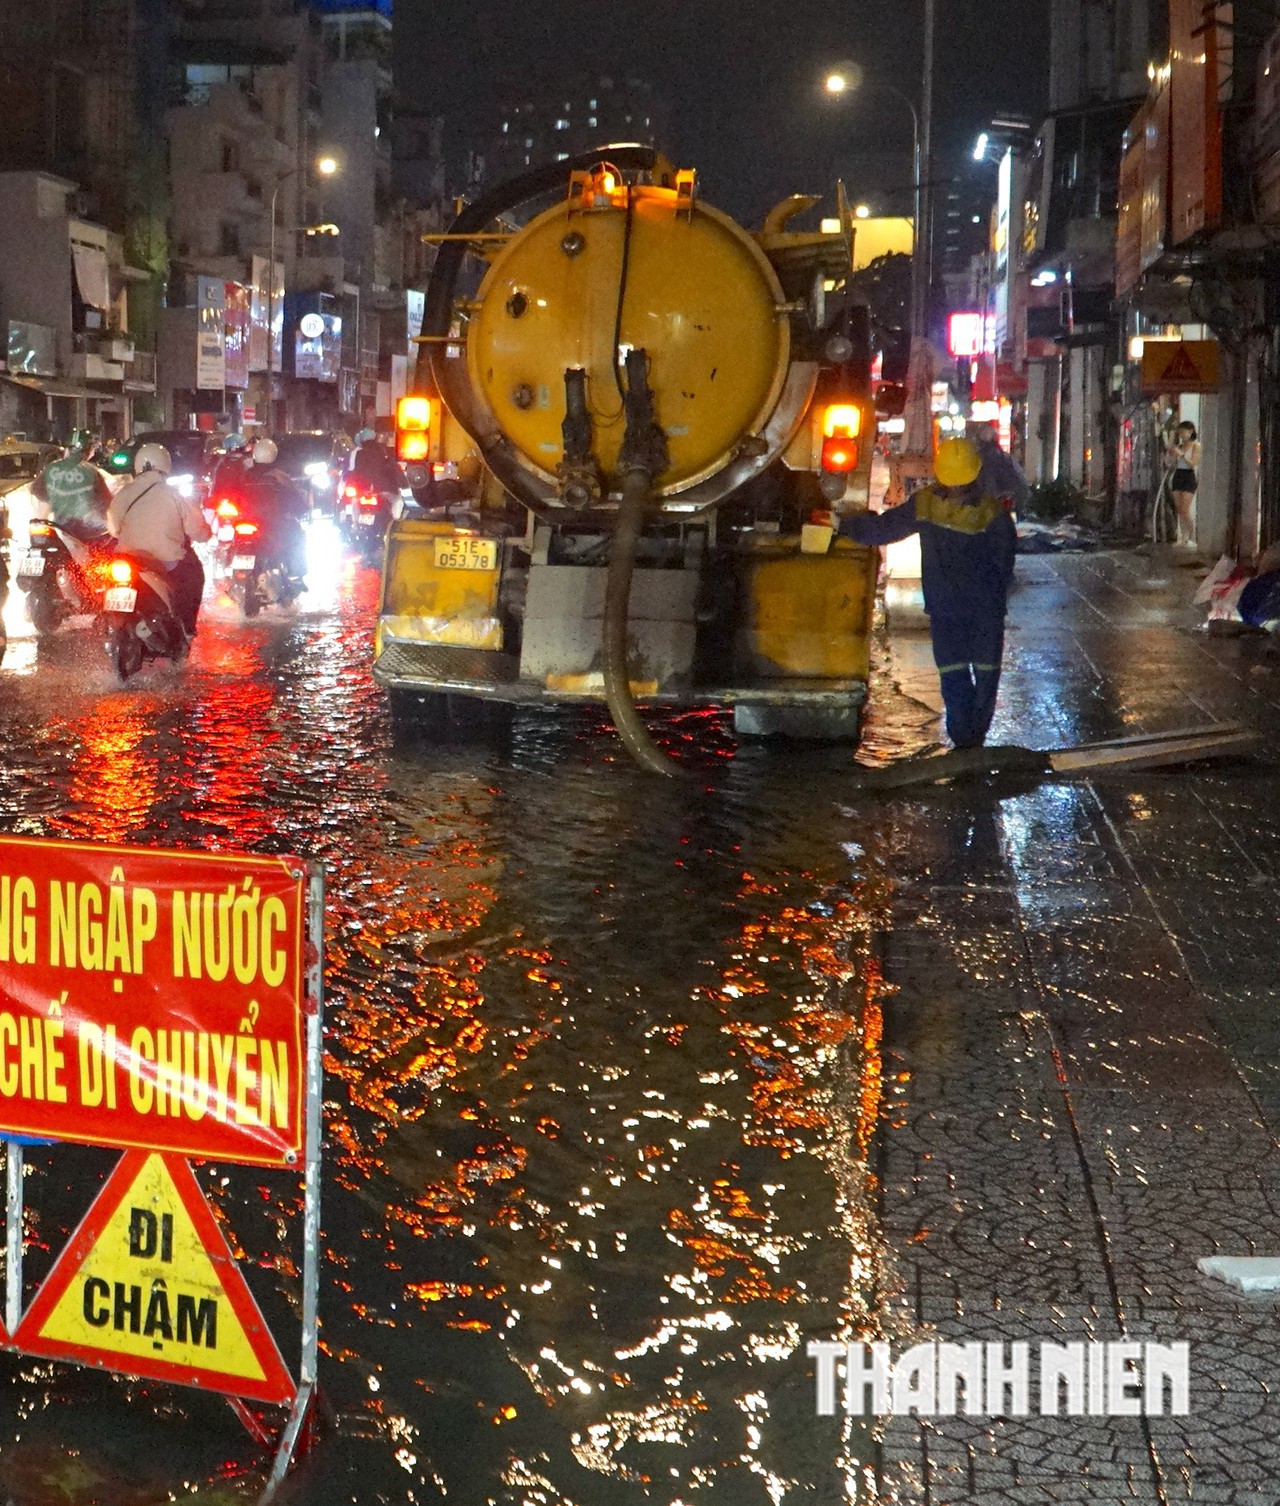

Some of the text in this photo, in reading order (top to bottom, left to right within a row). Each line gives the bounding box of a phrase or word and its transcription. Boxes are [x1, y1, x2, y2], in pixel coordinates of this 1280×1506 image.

[439, 553, 489, 568] 053.78
[452, 541, 479, 554] 51E
[49, 866, 158, 993] NGẬP
[171, 876, 288, 988] NƯỚC
[78, 1022, 117, 1110] DI
[129, 1000, 290, 1129] CHUYỂN
[128, 1206, 175, 1265] ĐI
[82, 1276, 219, 1352] CHẬM
